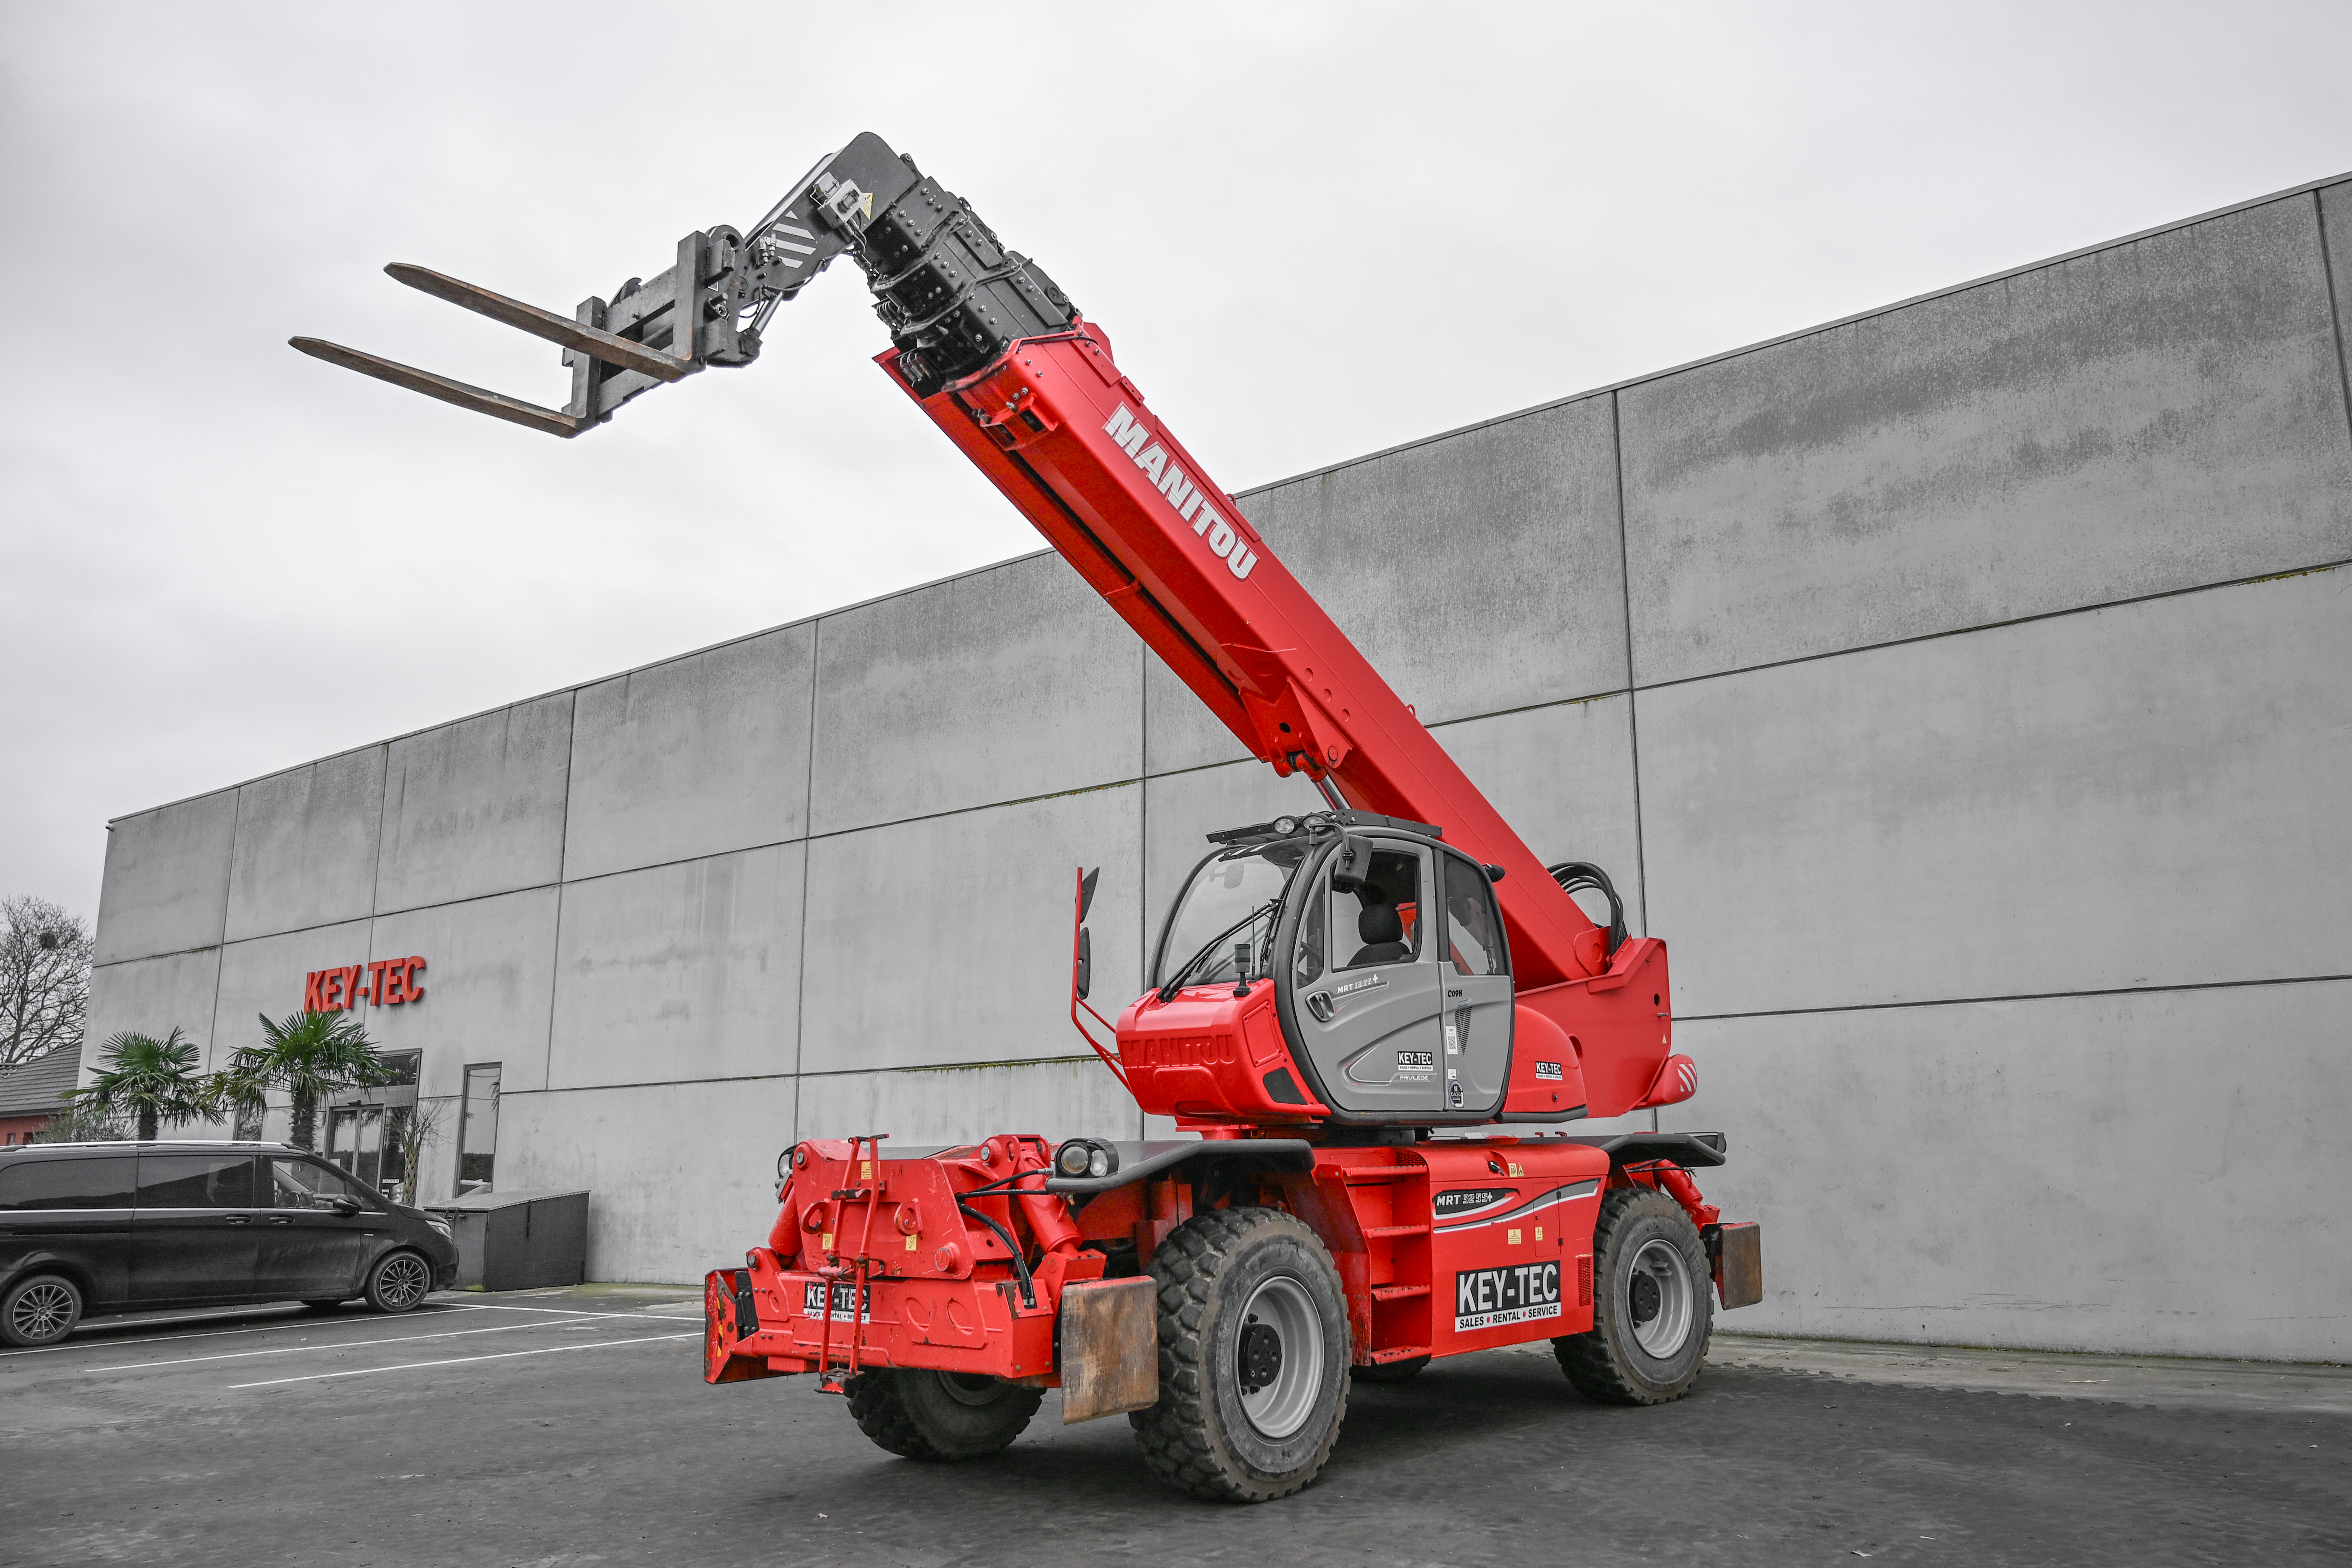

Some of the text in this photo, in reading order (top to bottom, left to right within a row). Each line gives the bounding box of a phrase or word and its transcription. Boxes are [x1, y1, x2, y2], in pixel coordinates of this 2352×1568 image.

[1102, 402, 1260, 581] MANITOU
[304, 956, 425, 1014] KEY-TEC
[1337, 984, 1353, 994] MRT
[1447, 989, 1462, 998] C098
[1120, 1034, 1235, 1068] MANITOU
[1399, 1052, 1432, 1064] KEY-TEC
[1536, 1062, 1561, 1074] KEY-TEC
[1437, 1195, 1461, 1206] MRT
[1459, 1264, 1558, 1313] KEY-TEC
[1460, 1305, 1557, 1329] SALES RENTAL SERVICE
